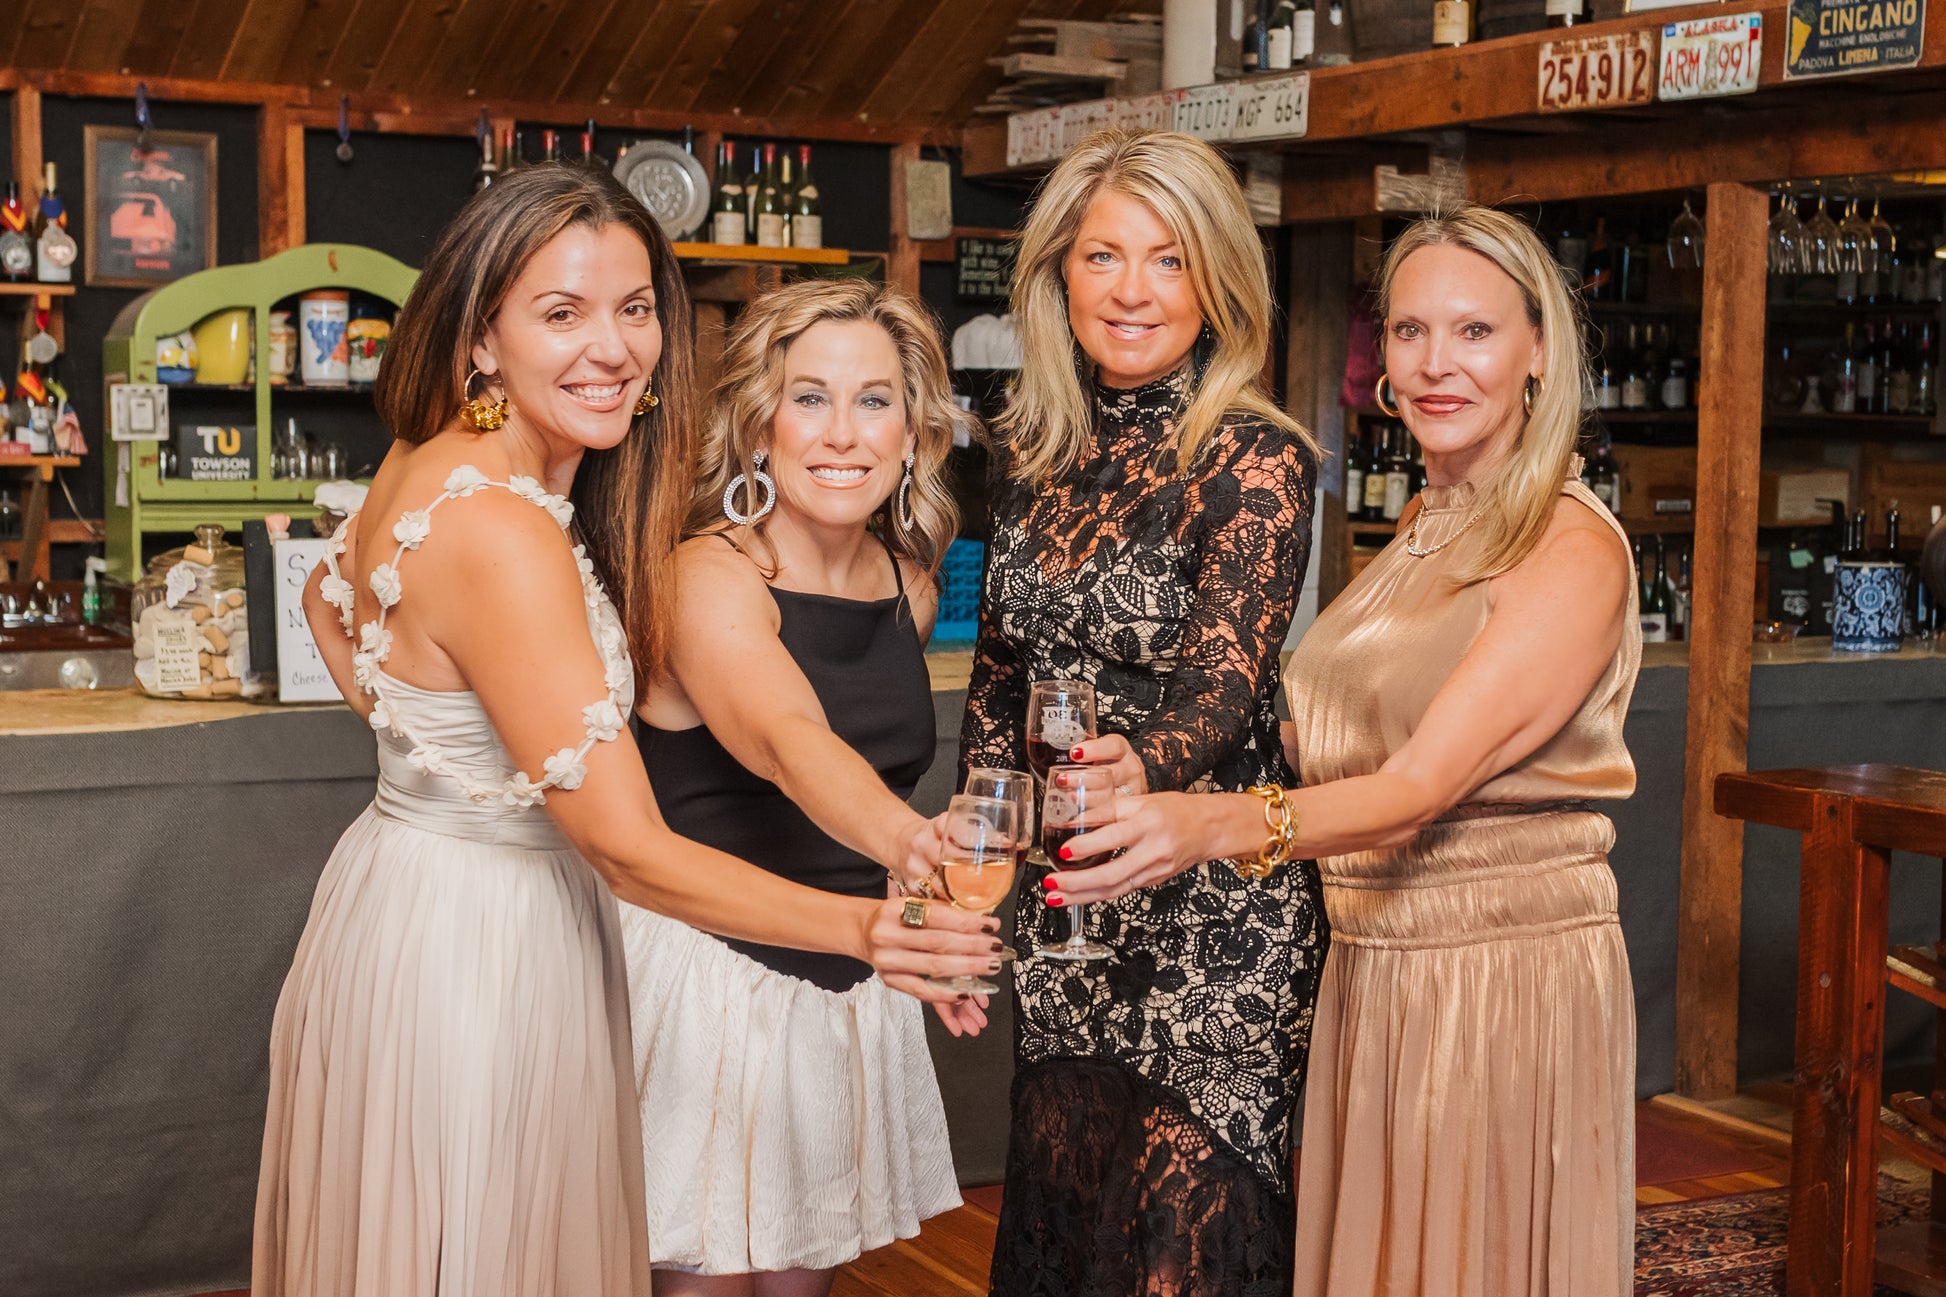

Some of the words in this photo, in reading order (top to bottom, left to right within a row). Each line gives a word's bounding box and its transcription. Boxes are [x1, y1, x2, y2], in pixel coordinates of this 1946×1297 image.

[1685, 18, 1739, 38] ALASKA
[1662, 50, 1701, 89] ARM
[1799, 56, 1834, 69] PADOVA
[1838, 47, 1878, 65] LIMENA
[1885, 45, 1915, 59] ITALIA
[1275, 91, 1303, 123] 664
[196, 425, 241, 455] TU
[191, 456, 251, 471] TOWSON
